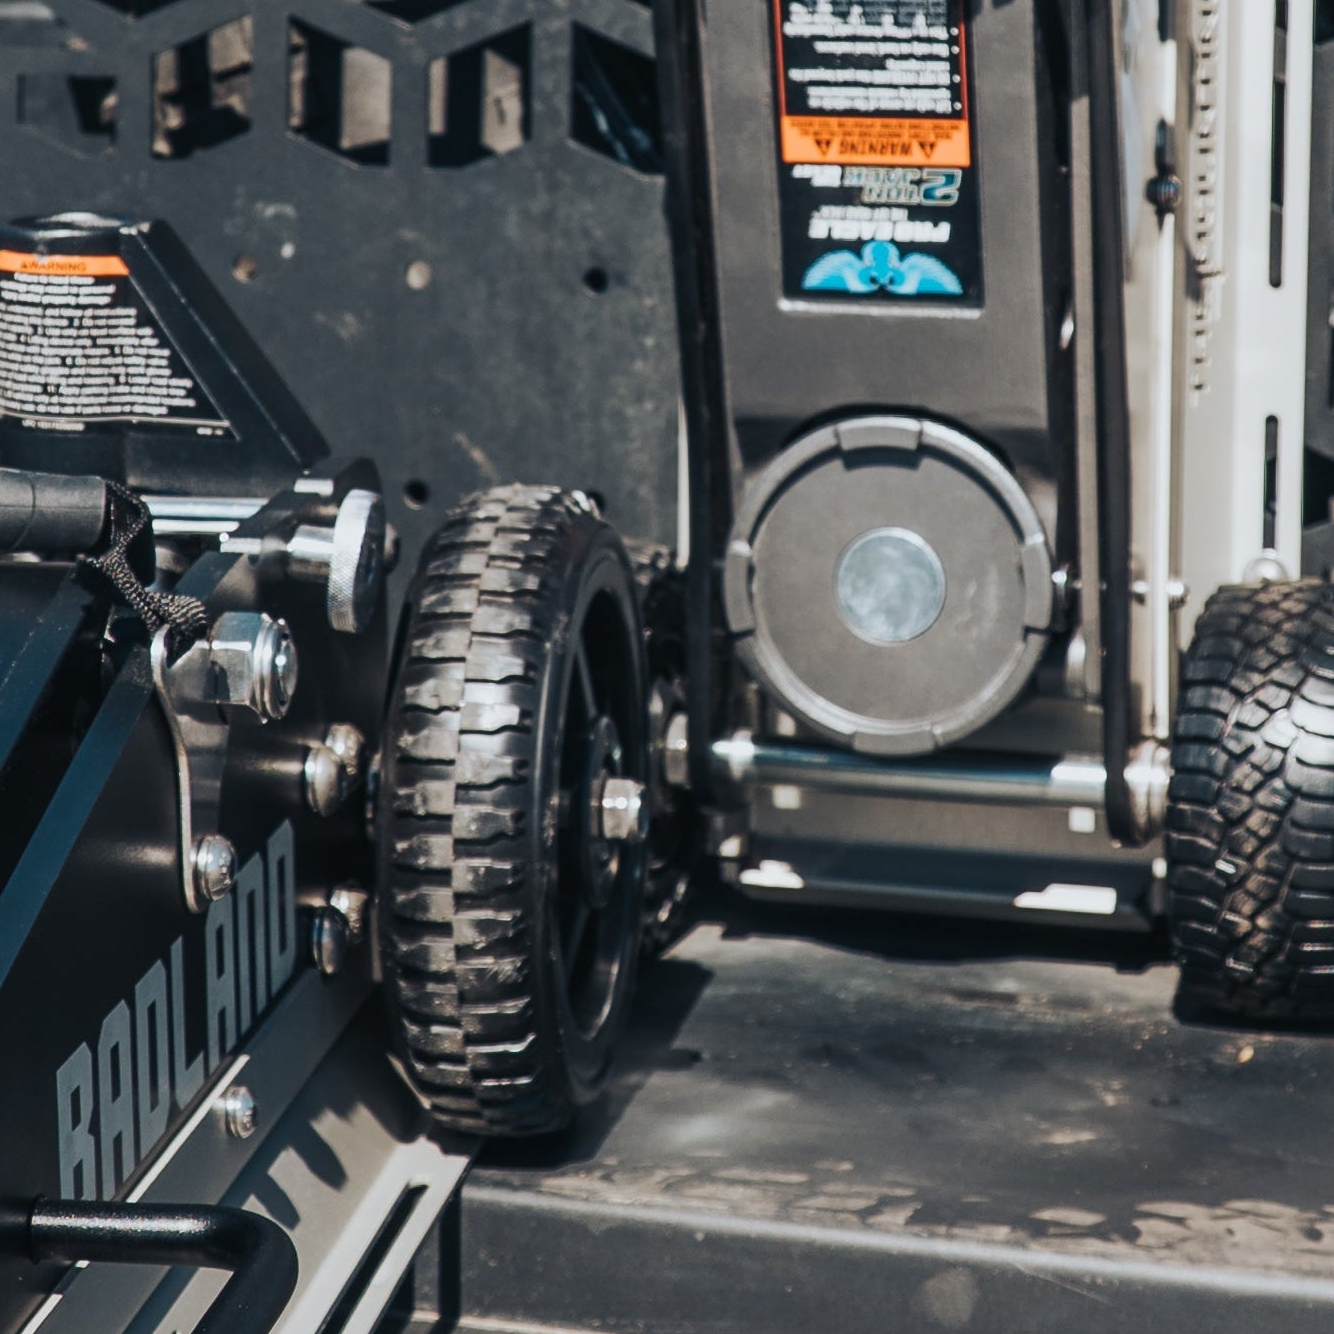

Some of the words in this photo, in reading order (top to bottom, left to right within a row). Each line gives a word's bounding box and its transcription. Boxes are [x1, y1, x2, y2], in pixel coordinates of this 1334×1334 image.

[838, 140, 914, 156] WARNING
[27, 260, 87, 271] WARNING
[55, 818, 296, 1203] BADLAND
